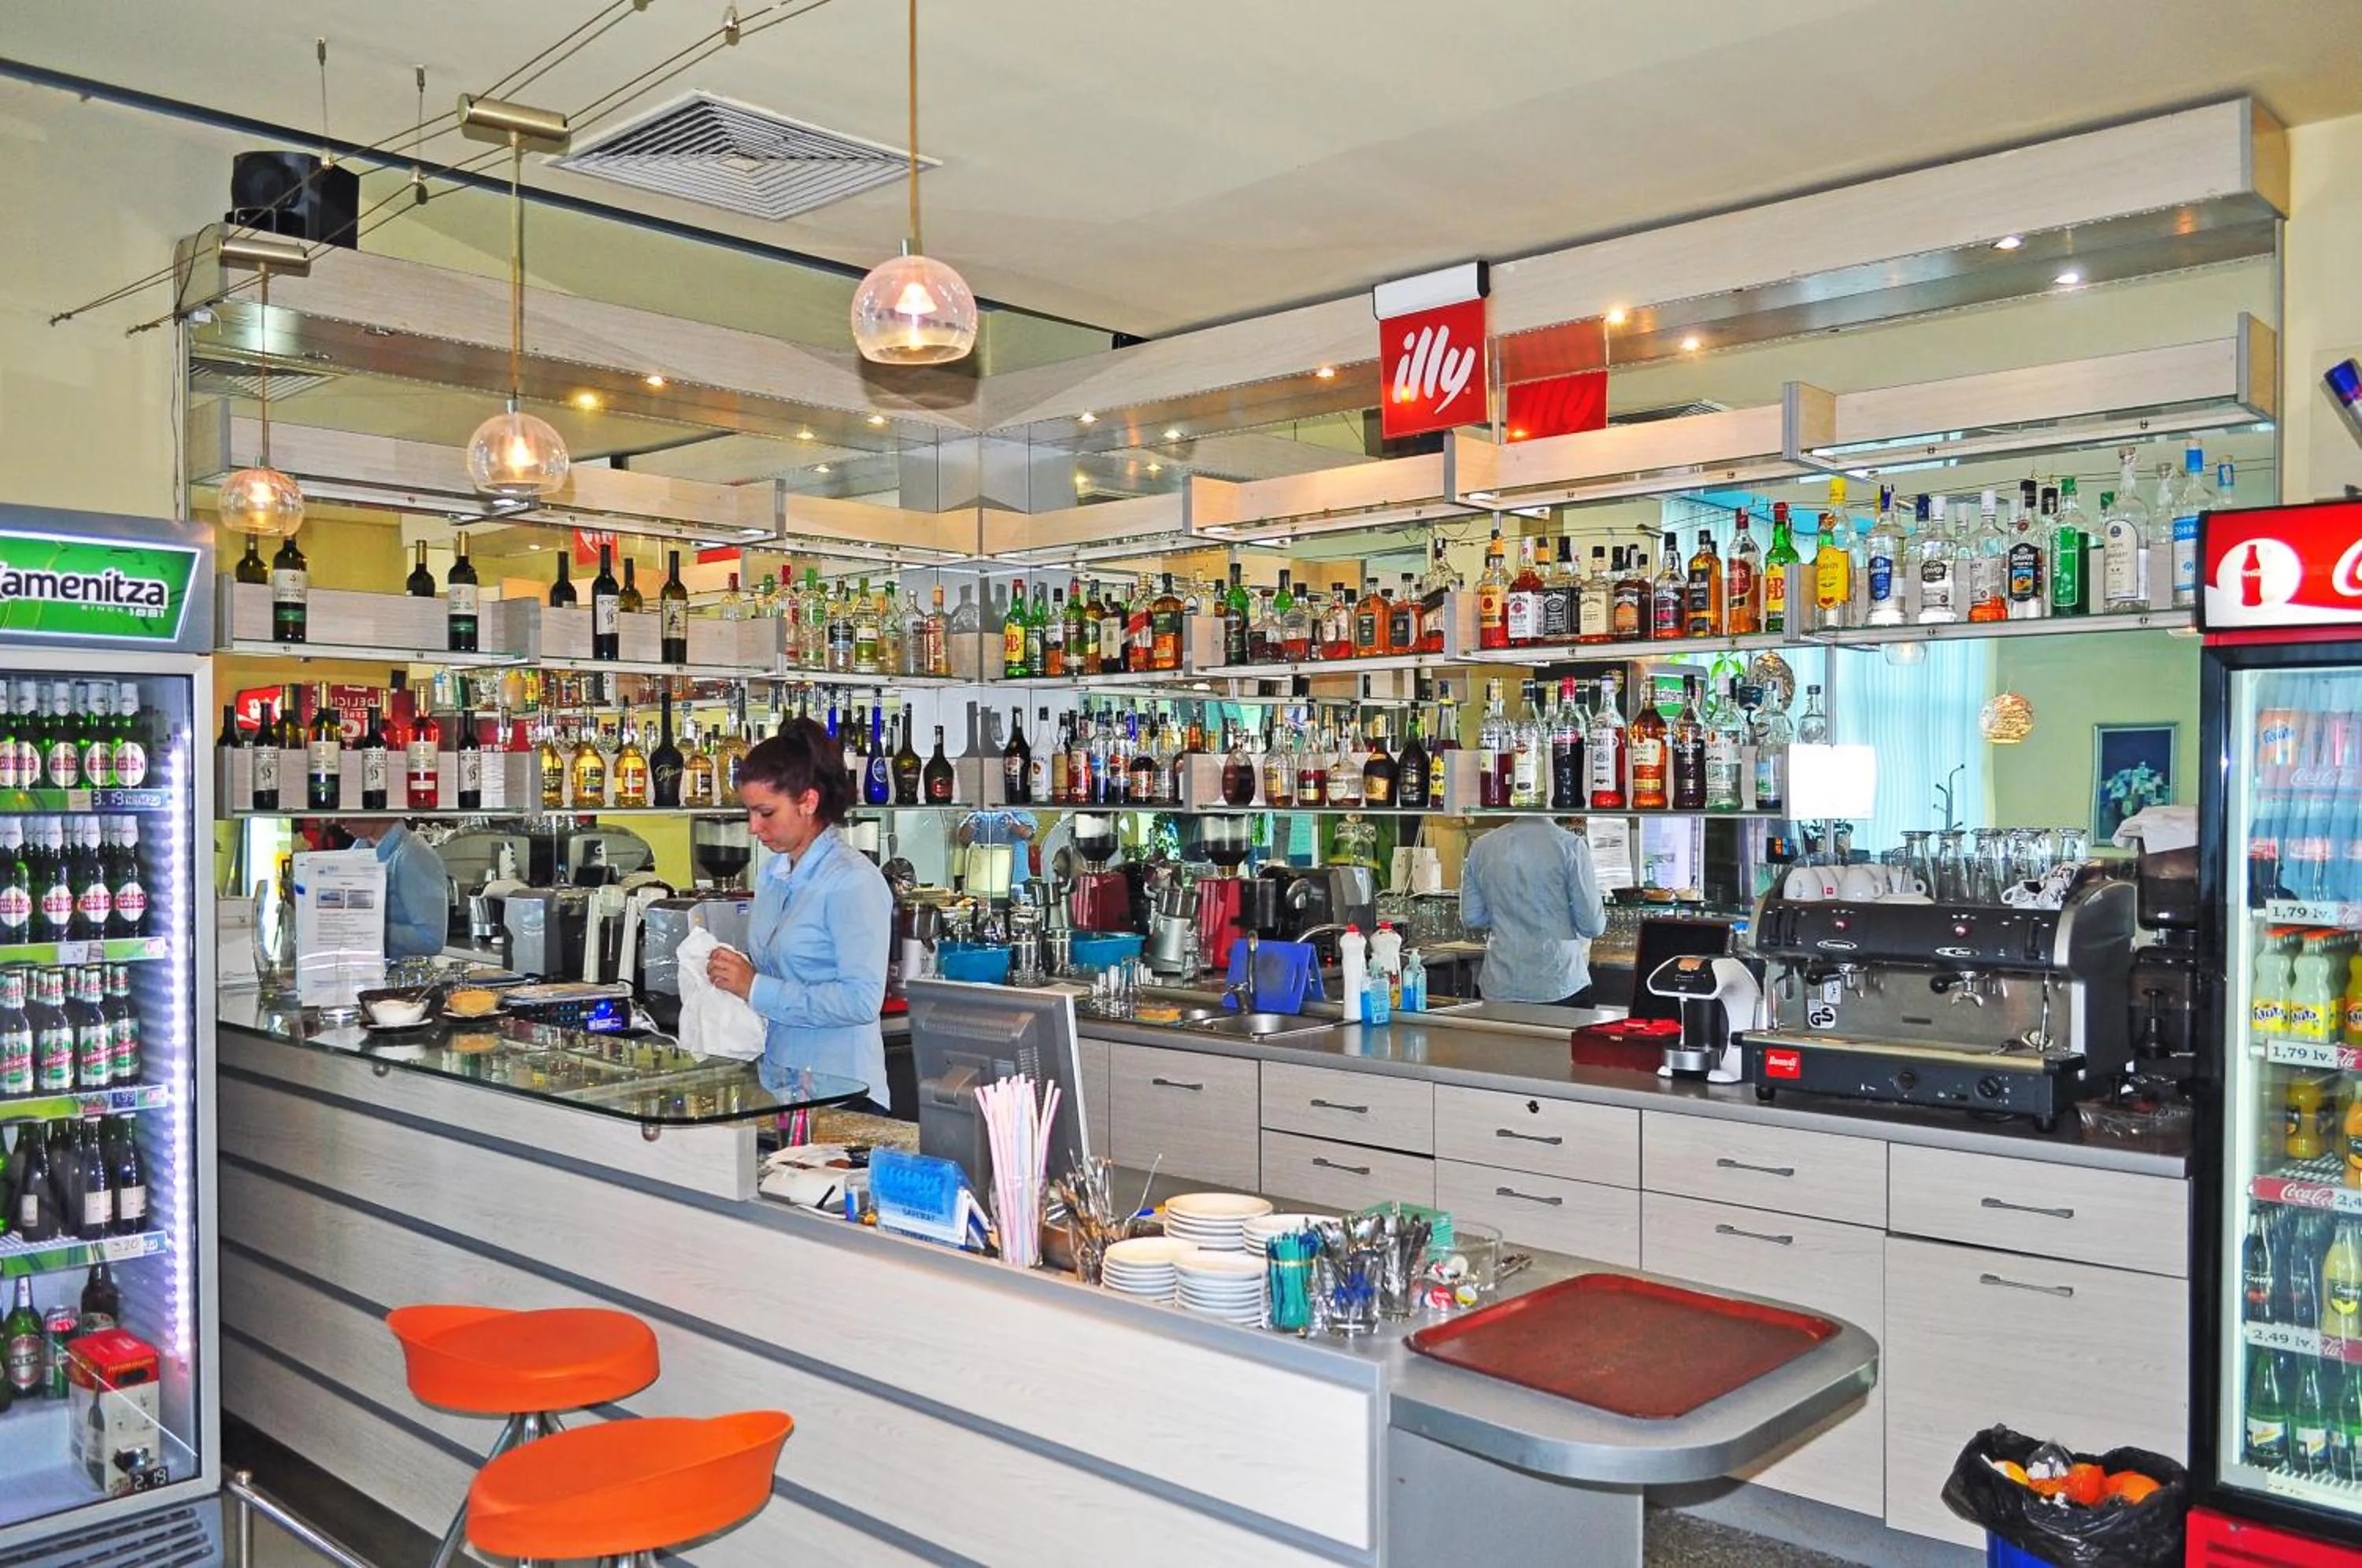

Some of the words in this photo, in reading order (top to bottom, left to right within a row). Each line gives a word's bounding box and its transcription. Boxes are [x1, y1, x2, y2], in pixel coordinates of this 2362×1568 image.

[1392, 324, 1476, 415] illy
[0, 561, 165, 607] amenitza
[2272, 906, 2308, 919] 1,79
[2312, 908, 2332, 920] lv.
[1810, 1007, 1834, 1026] GS
[2273, 1046, 2308, 1060] 1,79
[2312, 1050, 2333, 1063] lv.
[2253, 1329, 2290, 1344] 2,49
[134, 1468, 167, 1491] 2.19
